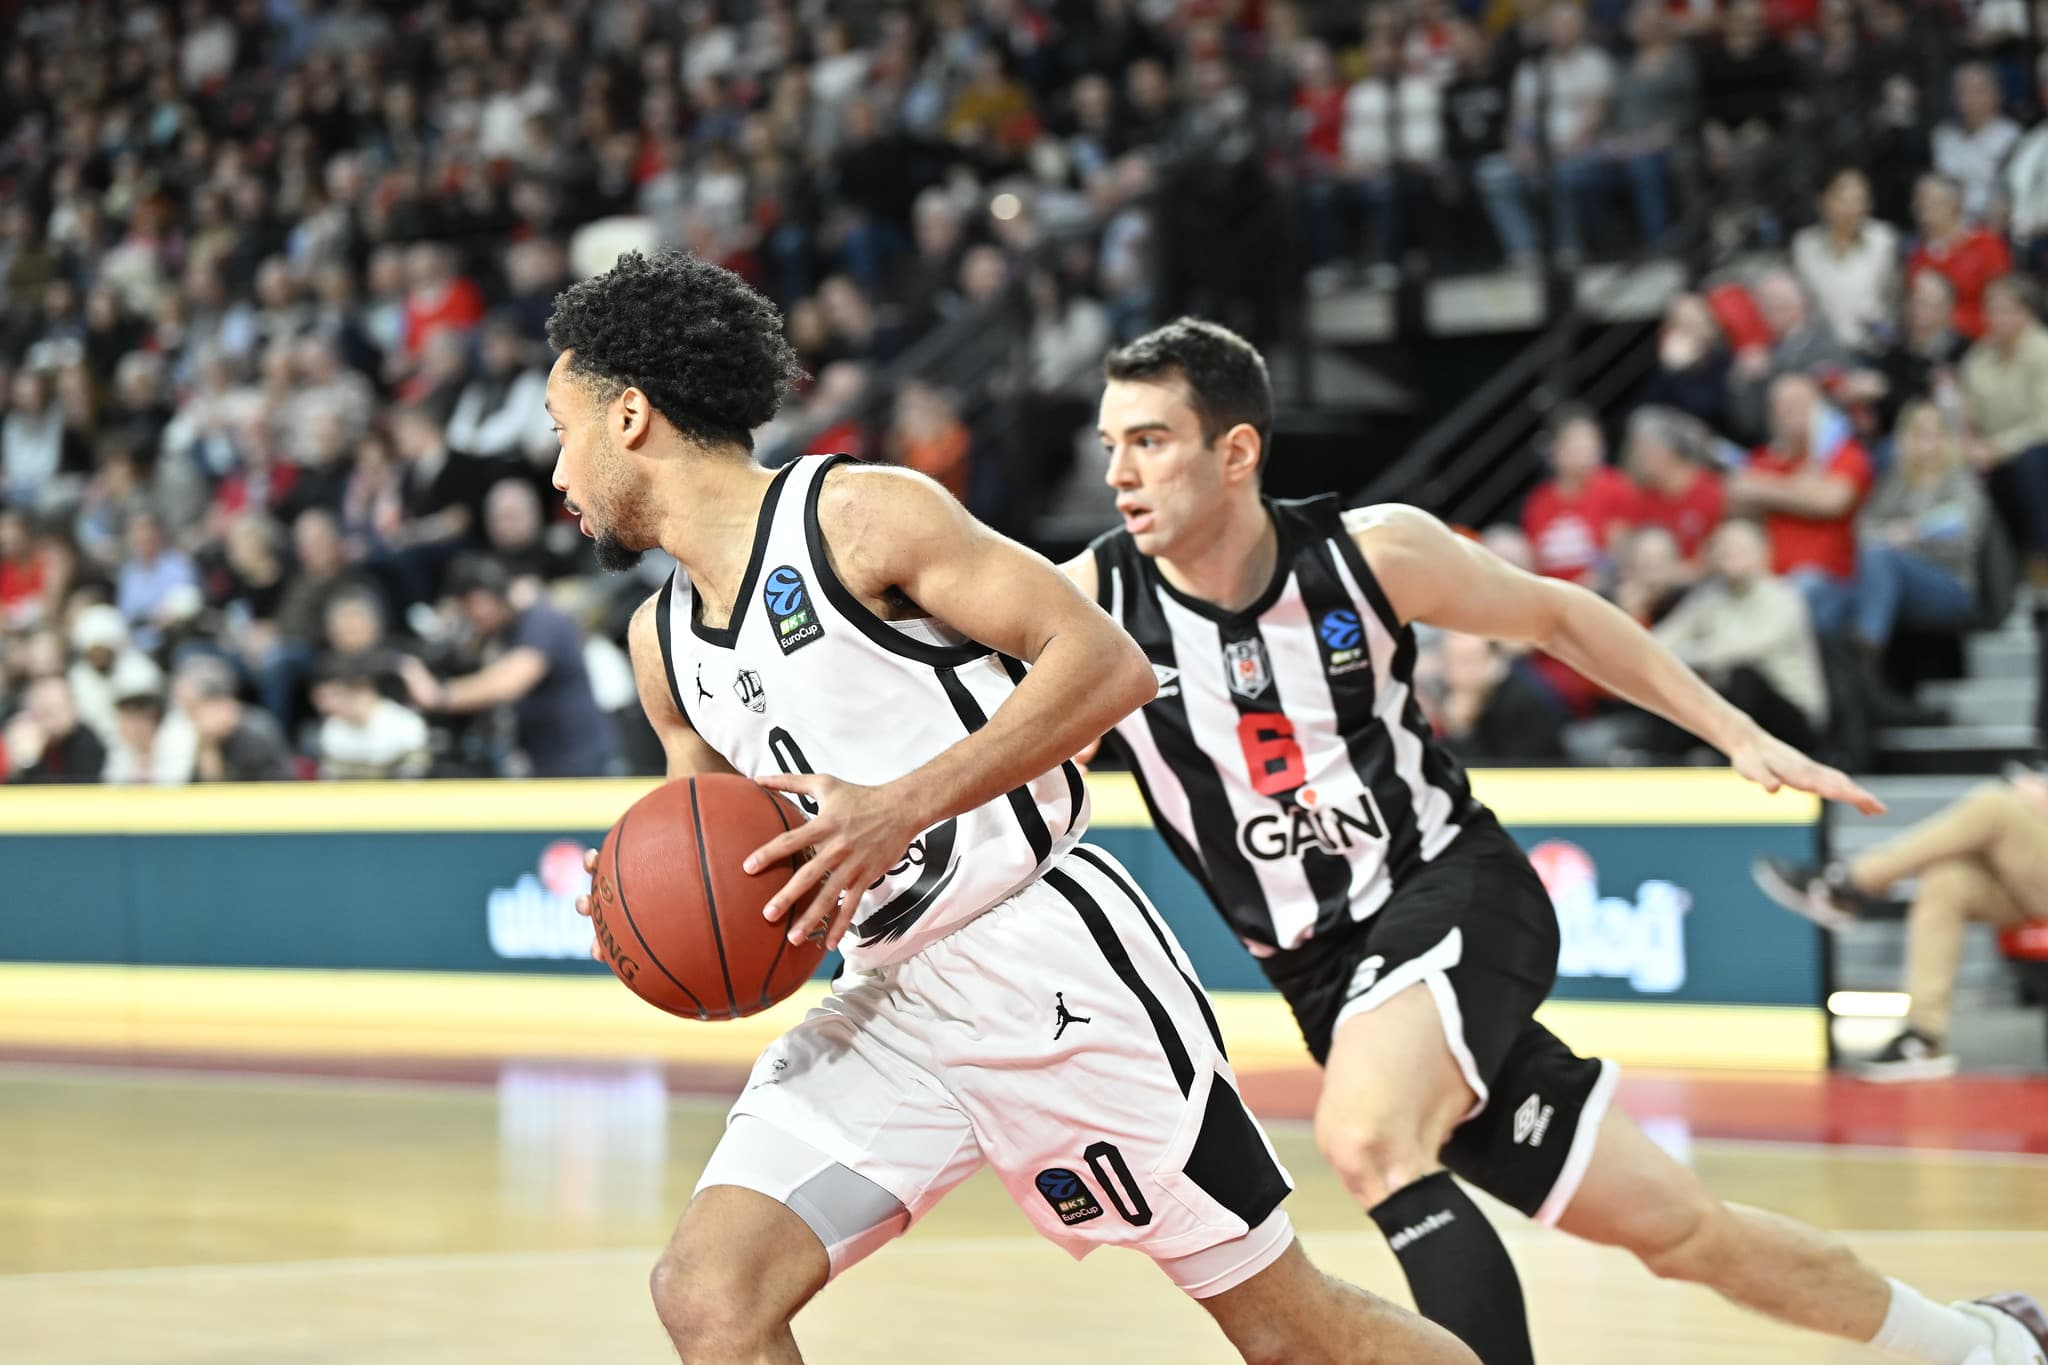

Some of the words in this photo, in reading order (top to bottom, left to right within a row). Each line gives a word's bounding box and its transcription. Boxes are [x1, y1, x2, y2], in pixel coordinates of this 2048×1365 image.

[779, 611, 809, 637] BKT
[780, 624, 819, 649] EuroCup
[1236, 712, 1307, 797] 6
[1083, 1140, 1153, 1227] 0
[1061, 1206, 1100, 1223] EuroCup
